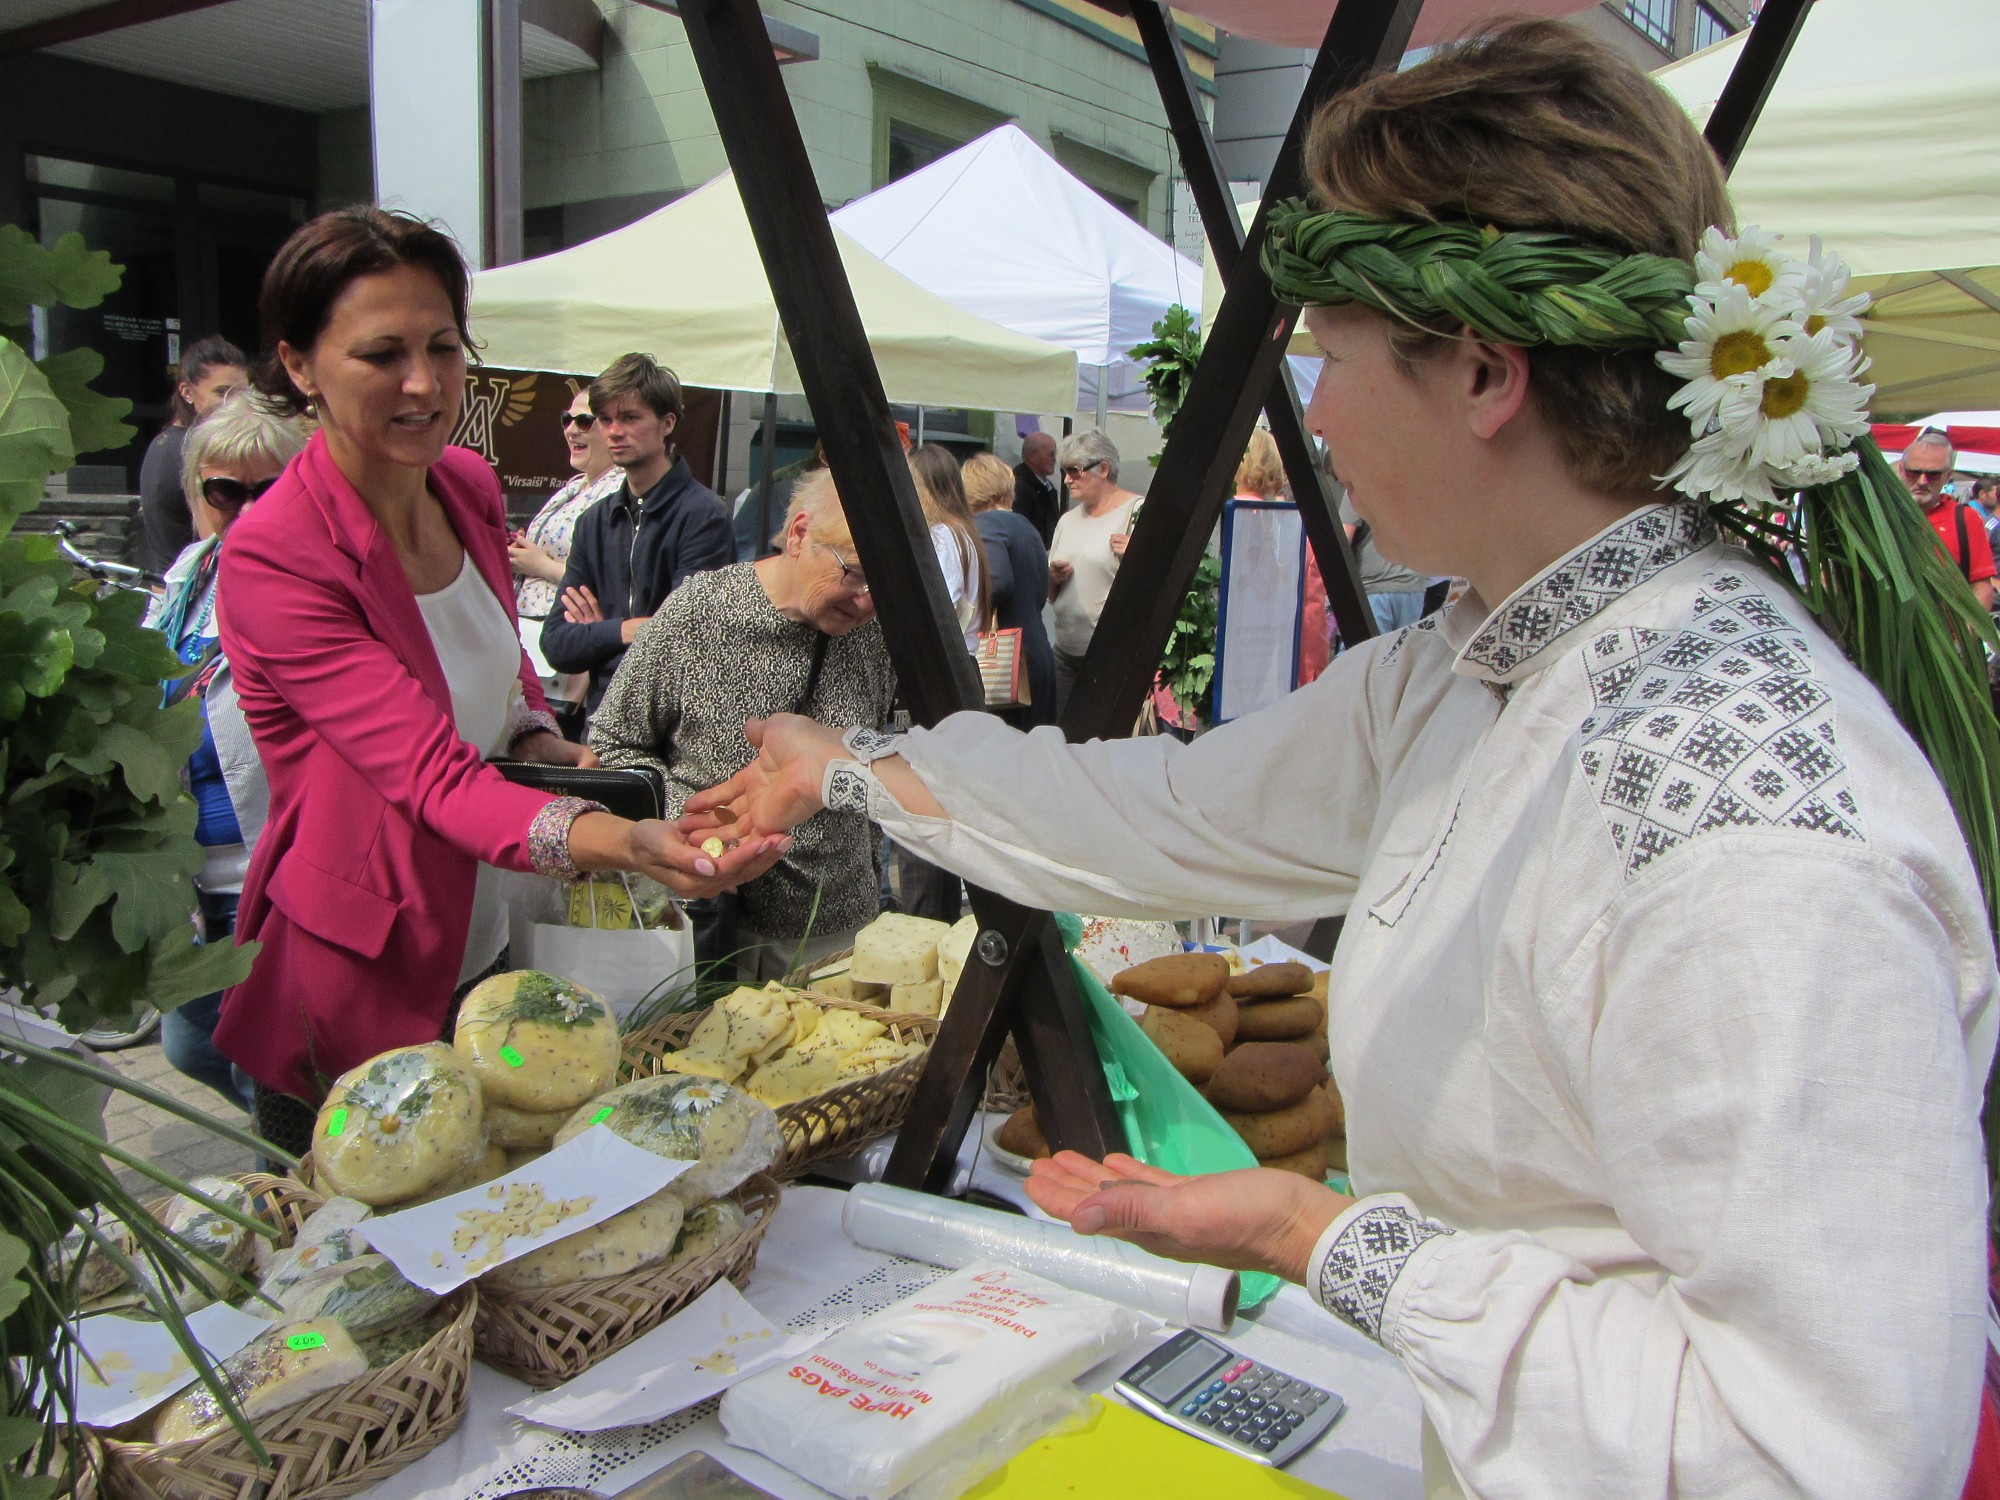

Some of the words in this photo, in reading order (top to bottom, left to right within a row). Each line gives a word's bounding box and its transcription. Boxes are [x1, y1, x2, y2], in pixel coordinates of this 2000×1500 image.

[976, 1311, 1037, 1339] pārtikas
[807, 1354, 879, 1388] fasēšanai
[788, 1366, 851, 1398] BAGS
[1216, 1400, 1228, 1408] 8
[1249, 1396, 1260, 1404] 6
[849, 1393, 914, 1420] HDPE
[1267, 1404, 1279, 1412] 3
[1202, 1411, 1212, 1420] 7
[1235, 1408, 1246, 1416] 5
[1223, 1419, 1232, 1428] 4
[1254, 1416, 1265, 1424] 2
[1260, 1437, 1271, 1445] 0
